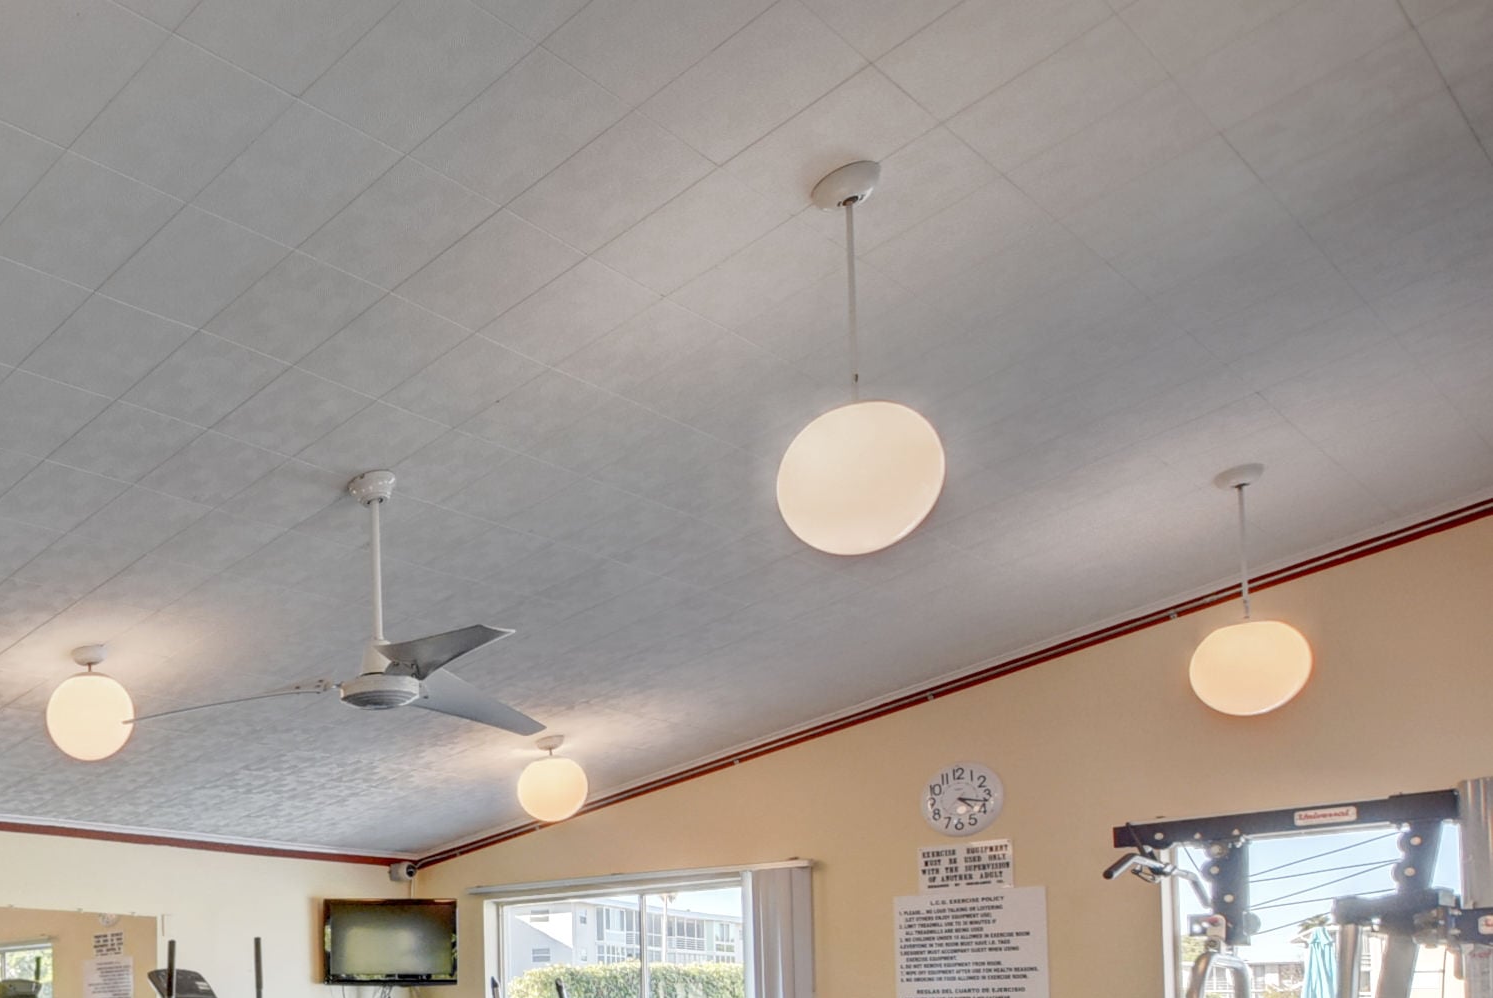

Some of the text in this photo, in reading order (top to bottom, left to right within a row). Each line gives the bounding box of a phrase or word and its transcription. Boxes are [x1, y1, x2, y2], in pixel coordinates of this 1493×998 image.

[941, 772, 949, 785] 11
[953, 767, 964, 780] 12
[977, 775, 987, 788] 2
[929, 784, 942, 796] 10
[984, 788, 991, 800] 3
[932, 808, 941, 820] 8
[968, 814, 977, 826] 5
[943, 816, 951, 829] 7
[955, 818, 964, 830] 6
[922, 844, 1009, 858] EXERCISE EQUIPMENT
[989, 853, 1007, 861] ONLY
[945, 866, 959, 874] THE
[965, 861, 1011, 872] SUPERVISION
[980, 870, 1003, 880] ADULT
